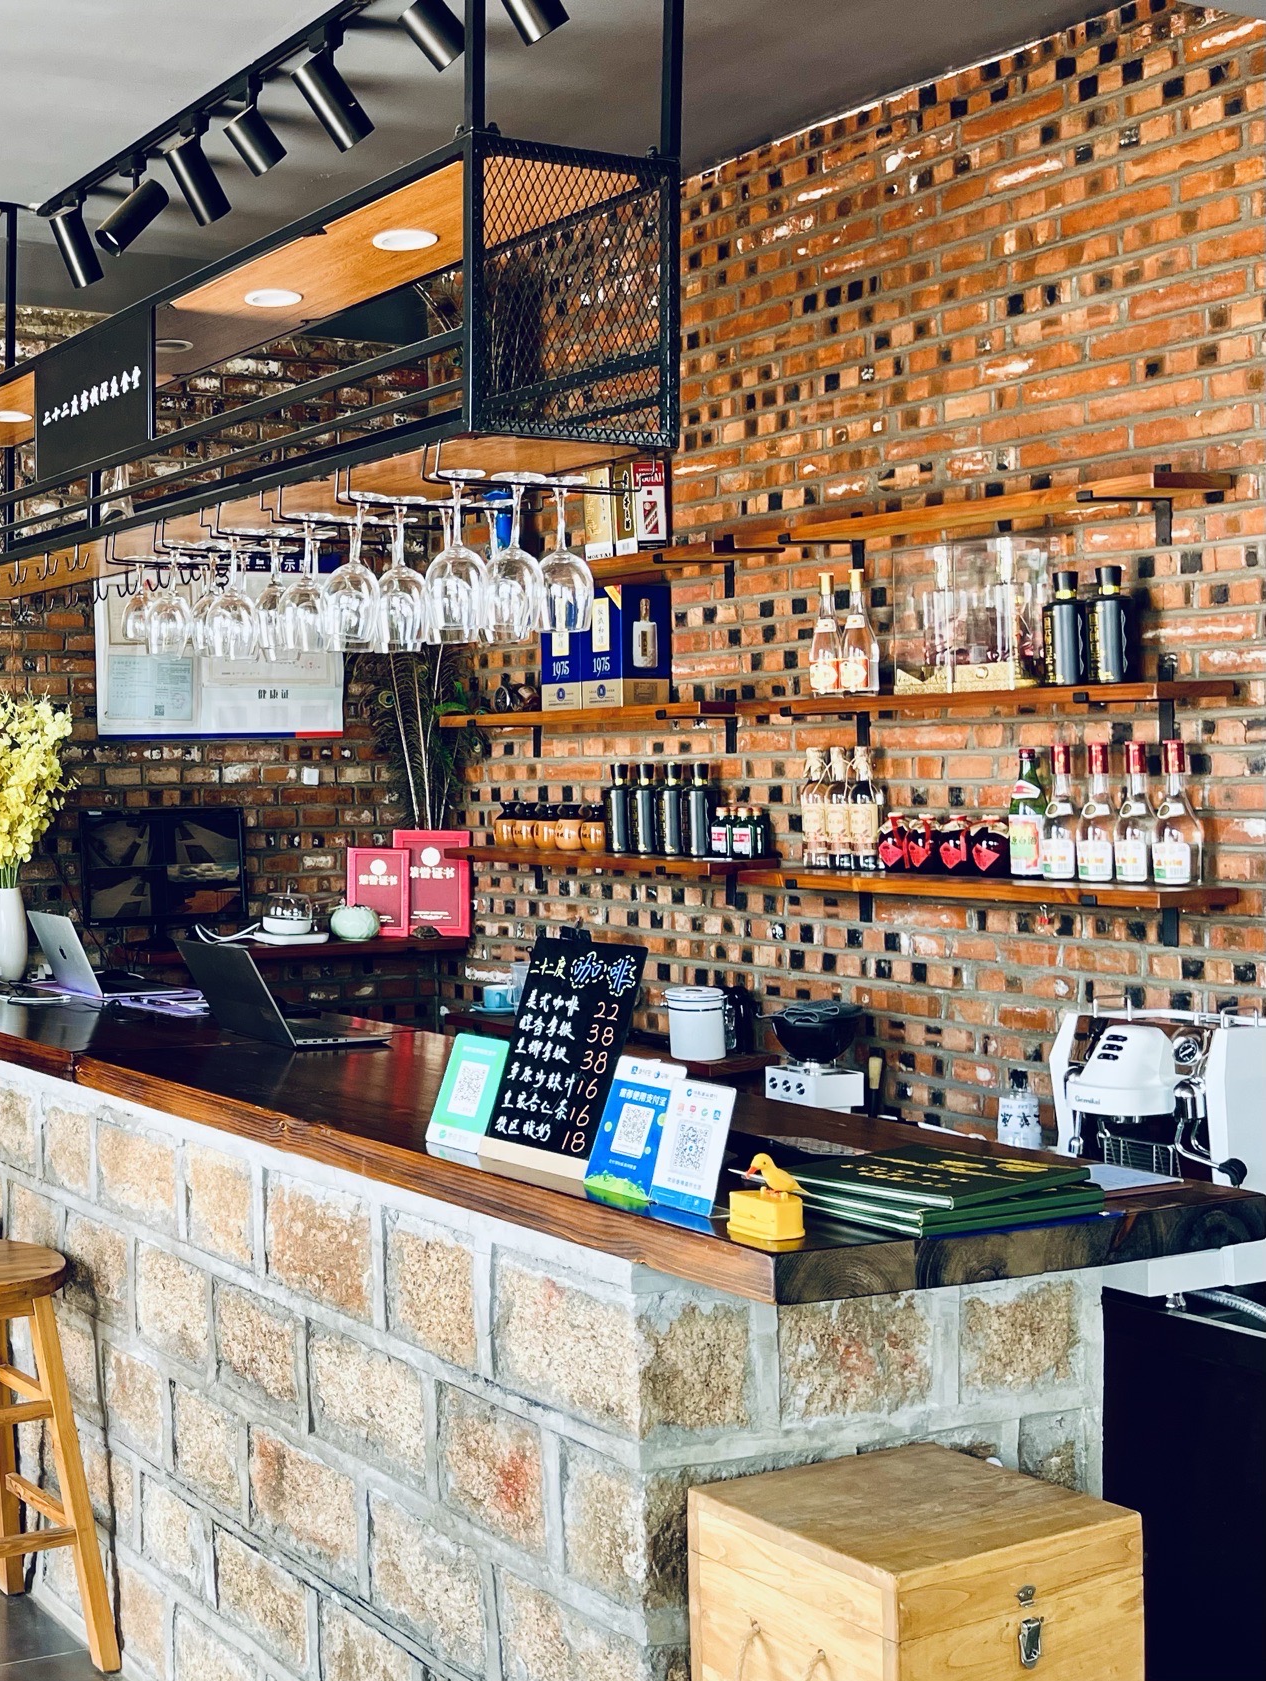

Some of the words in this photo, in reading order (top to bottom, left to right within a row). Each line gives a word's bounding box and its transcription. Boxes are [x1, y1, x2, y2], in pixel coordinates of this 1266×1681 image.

[552, 661, 569, 681] 1975
[593, 657, 610, 677] 1975
[530, 956, 566, 979] 二十二度
[574, 954, 632, 992] 咖啡
[525, 989, 579, 1016] 美式咖啡
[594, 1002, 619, 1021] 22
[587, 1024, 614, 1046] 38
[580, 1050, 607, 1074] 38
[576, 1076, 598, 1099] 16
[569, 1104, 590, 1127] 16
[561, 1130, 586, 1152] 18
